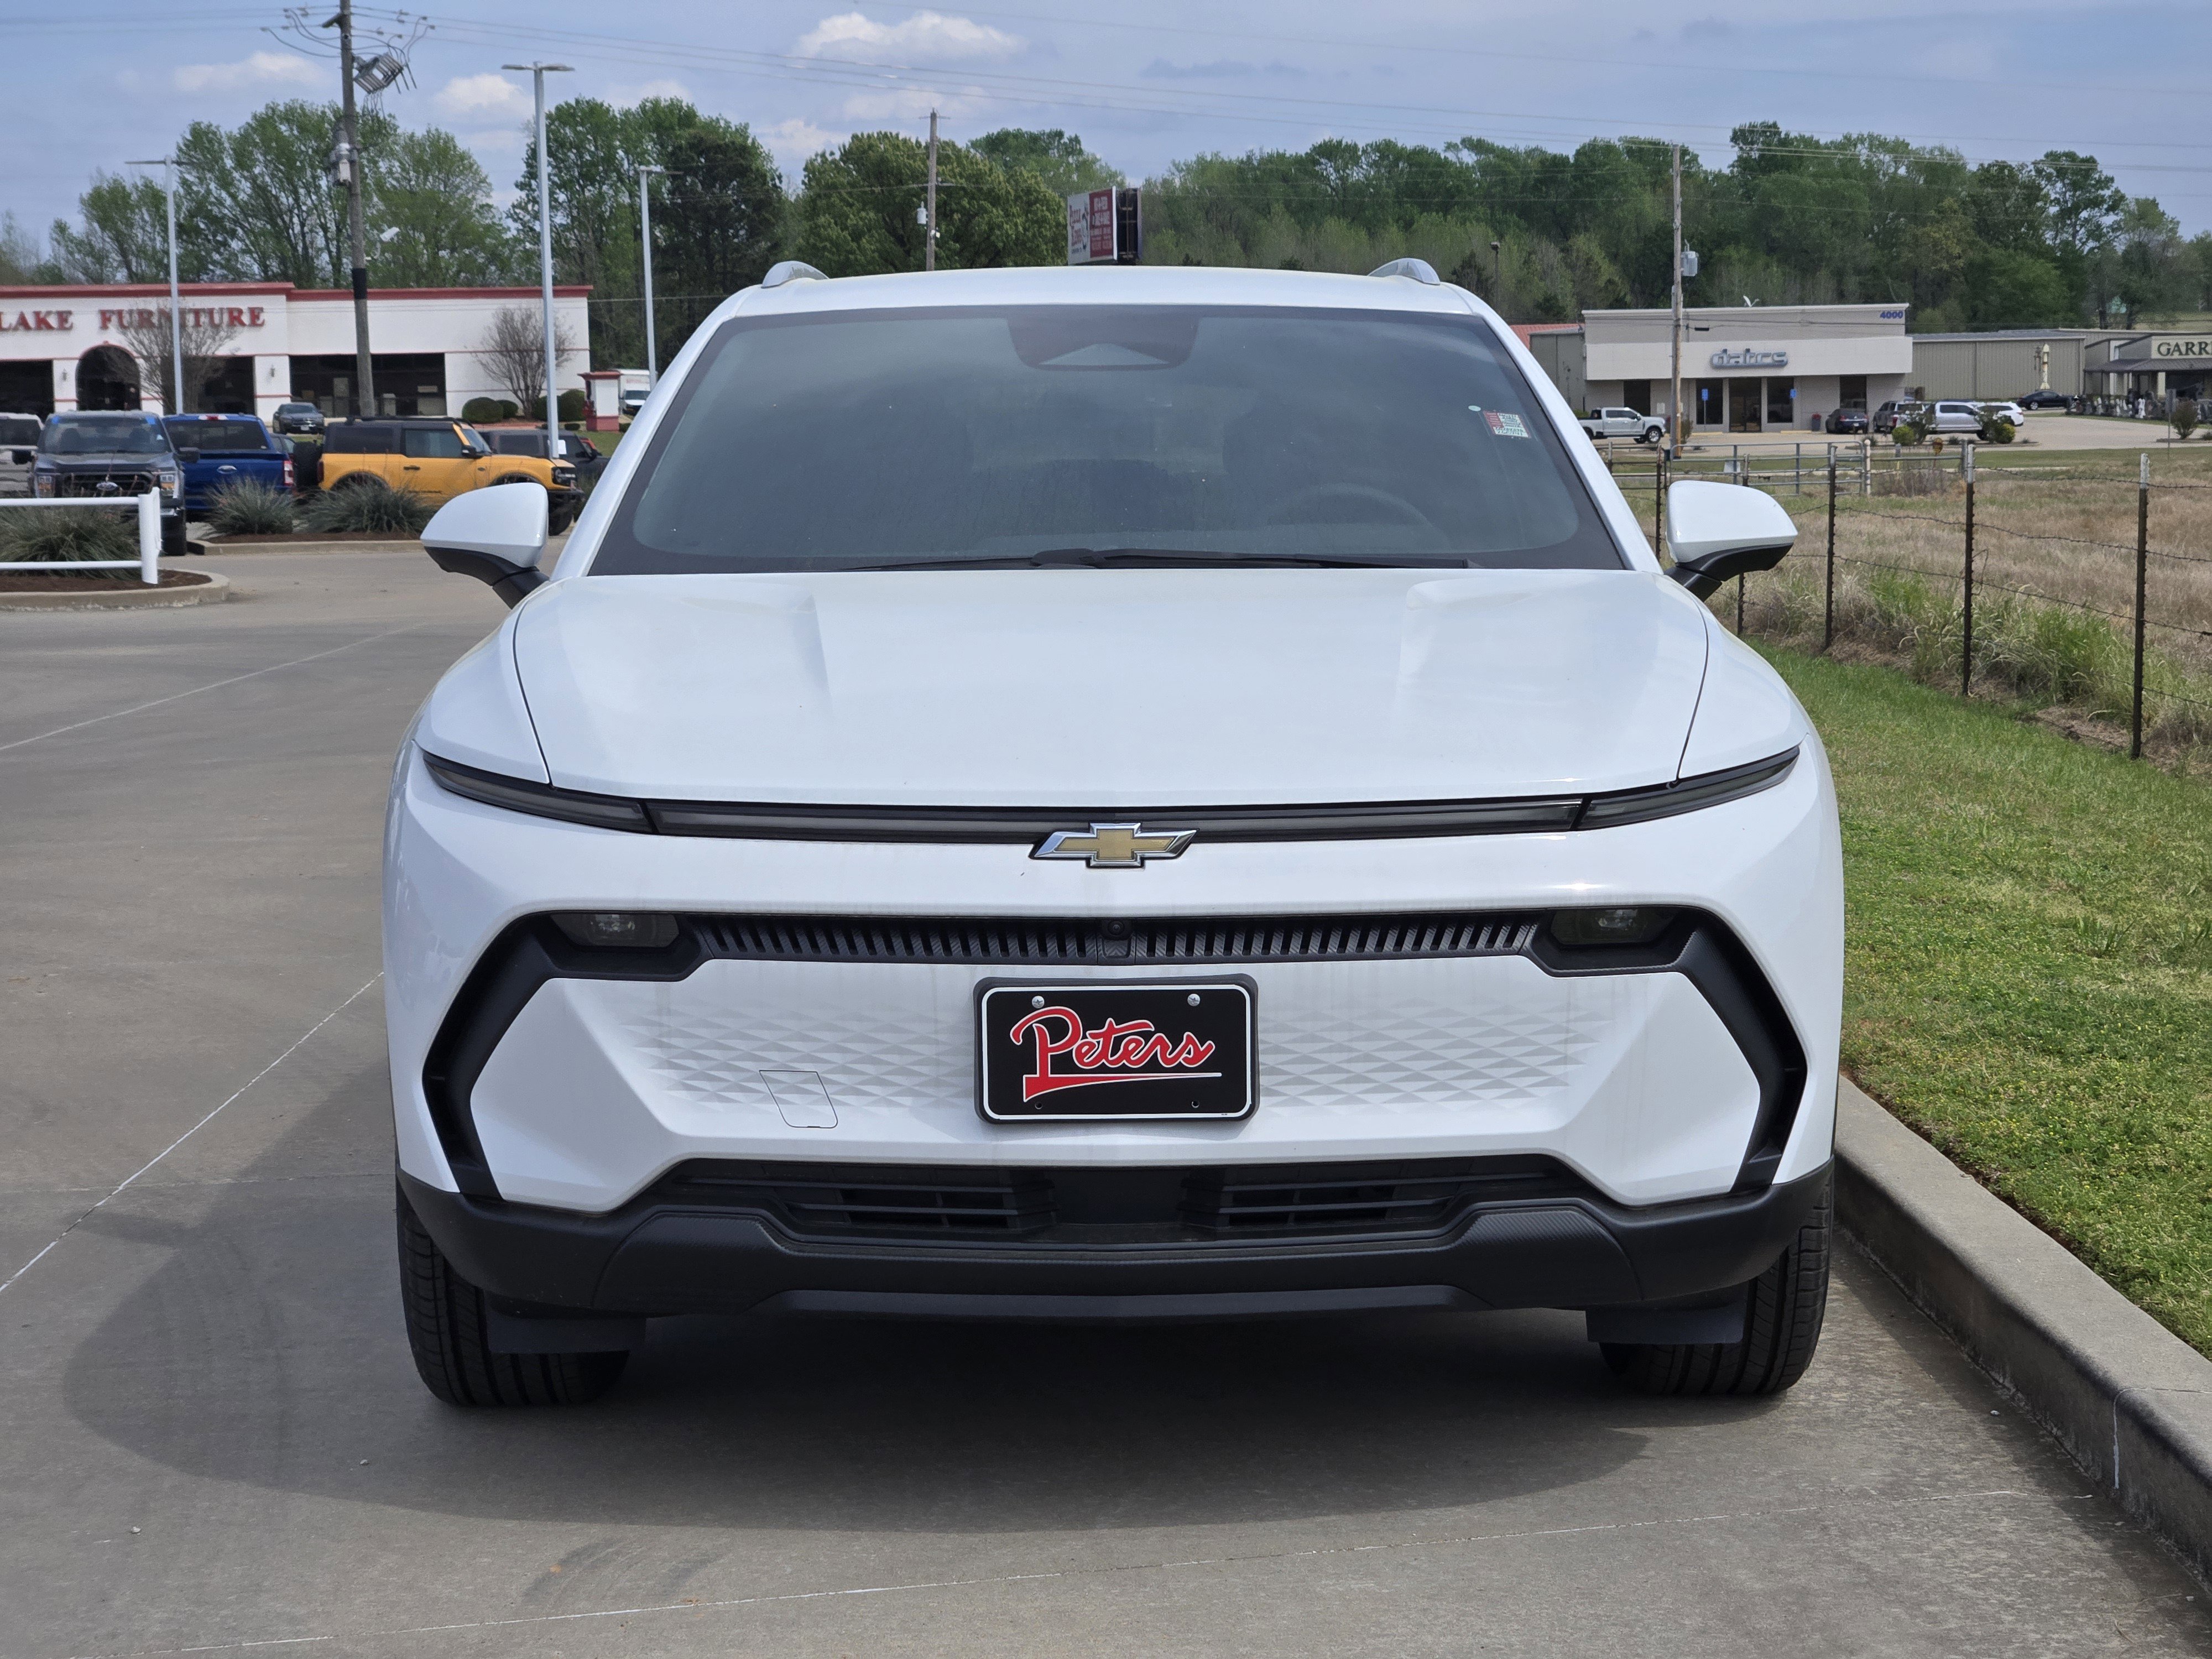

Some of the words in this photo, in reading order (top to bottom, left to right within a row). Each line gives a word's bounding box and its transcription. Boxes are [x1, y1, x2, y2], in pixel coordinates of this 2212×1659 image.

[98, 306, 265, 330] FURNITURE
[1880, 311, 1903, 319] 4000
[2157, 341, 2212, 357] GARR
[1010, 1006, 1217, 1100] Peters
